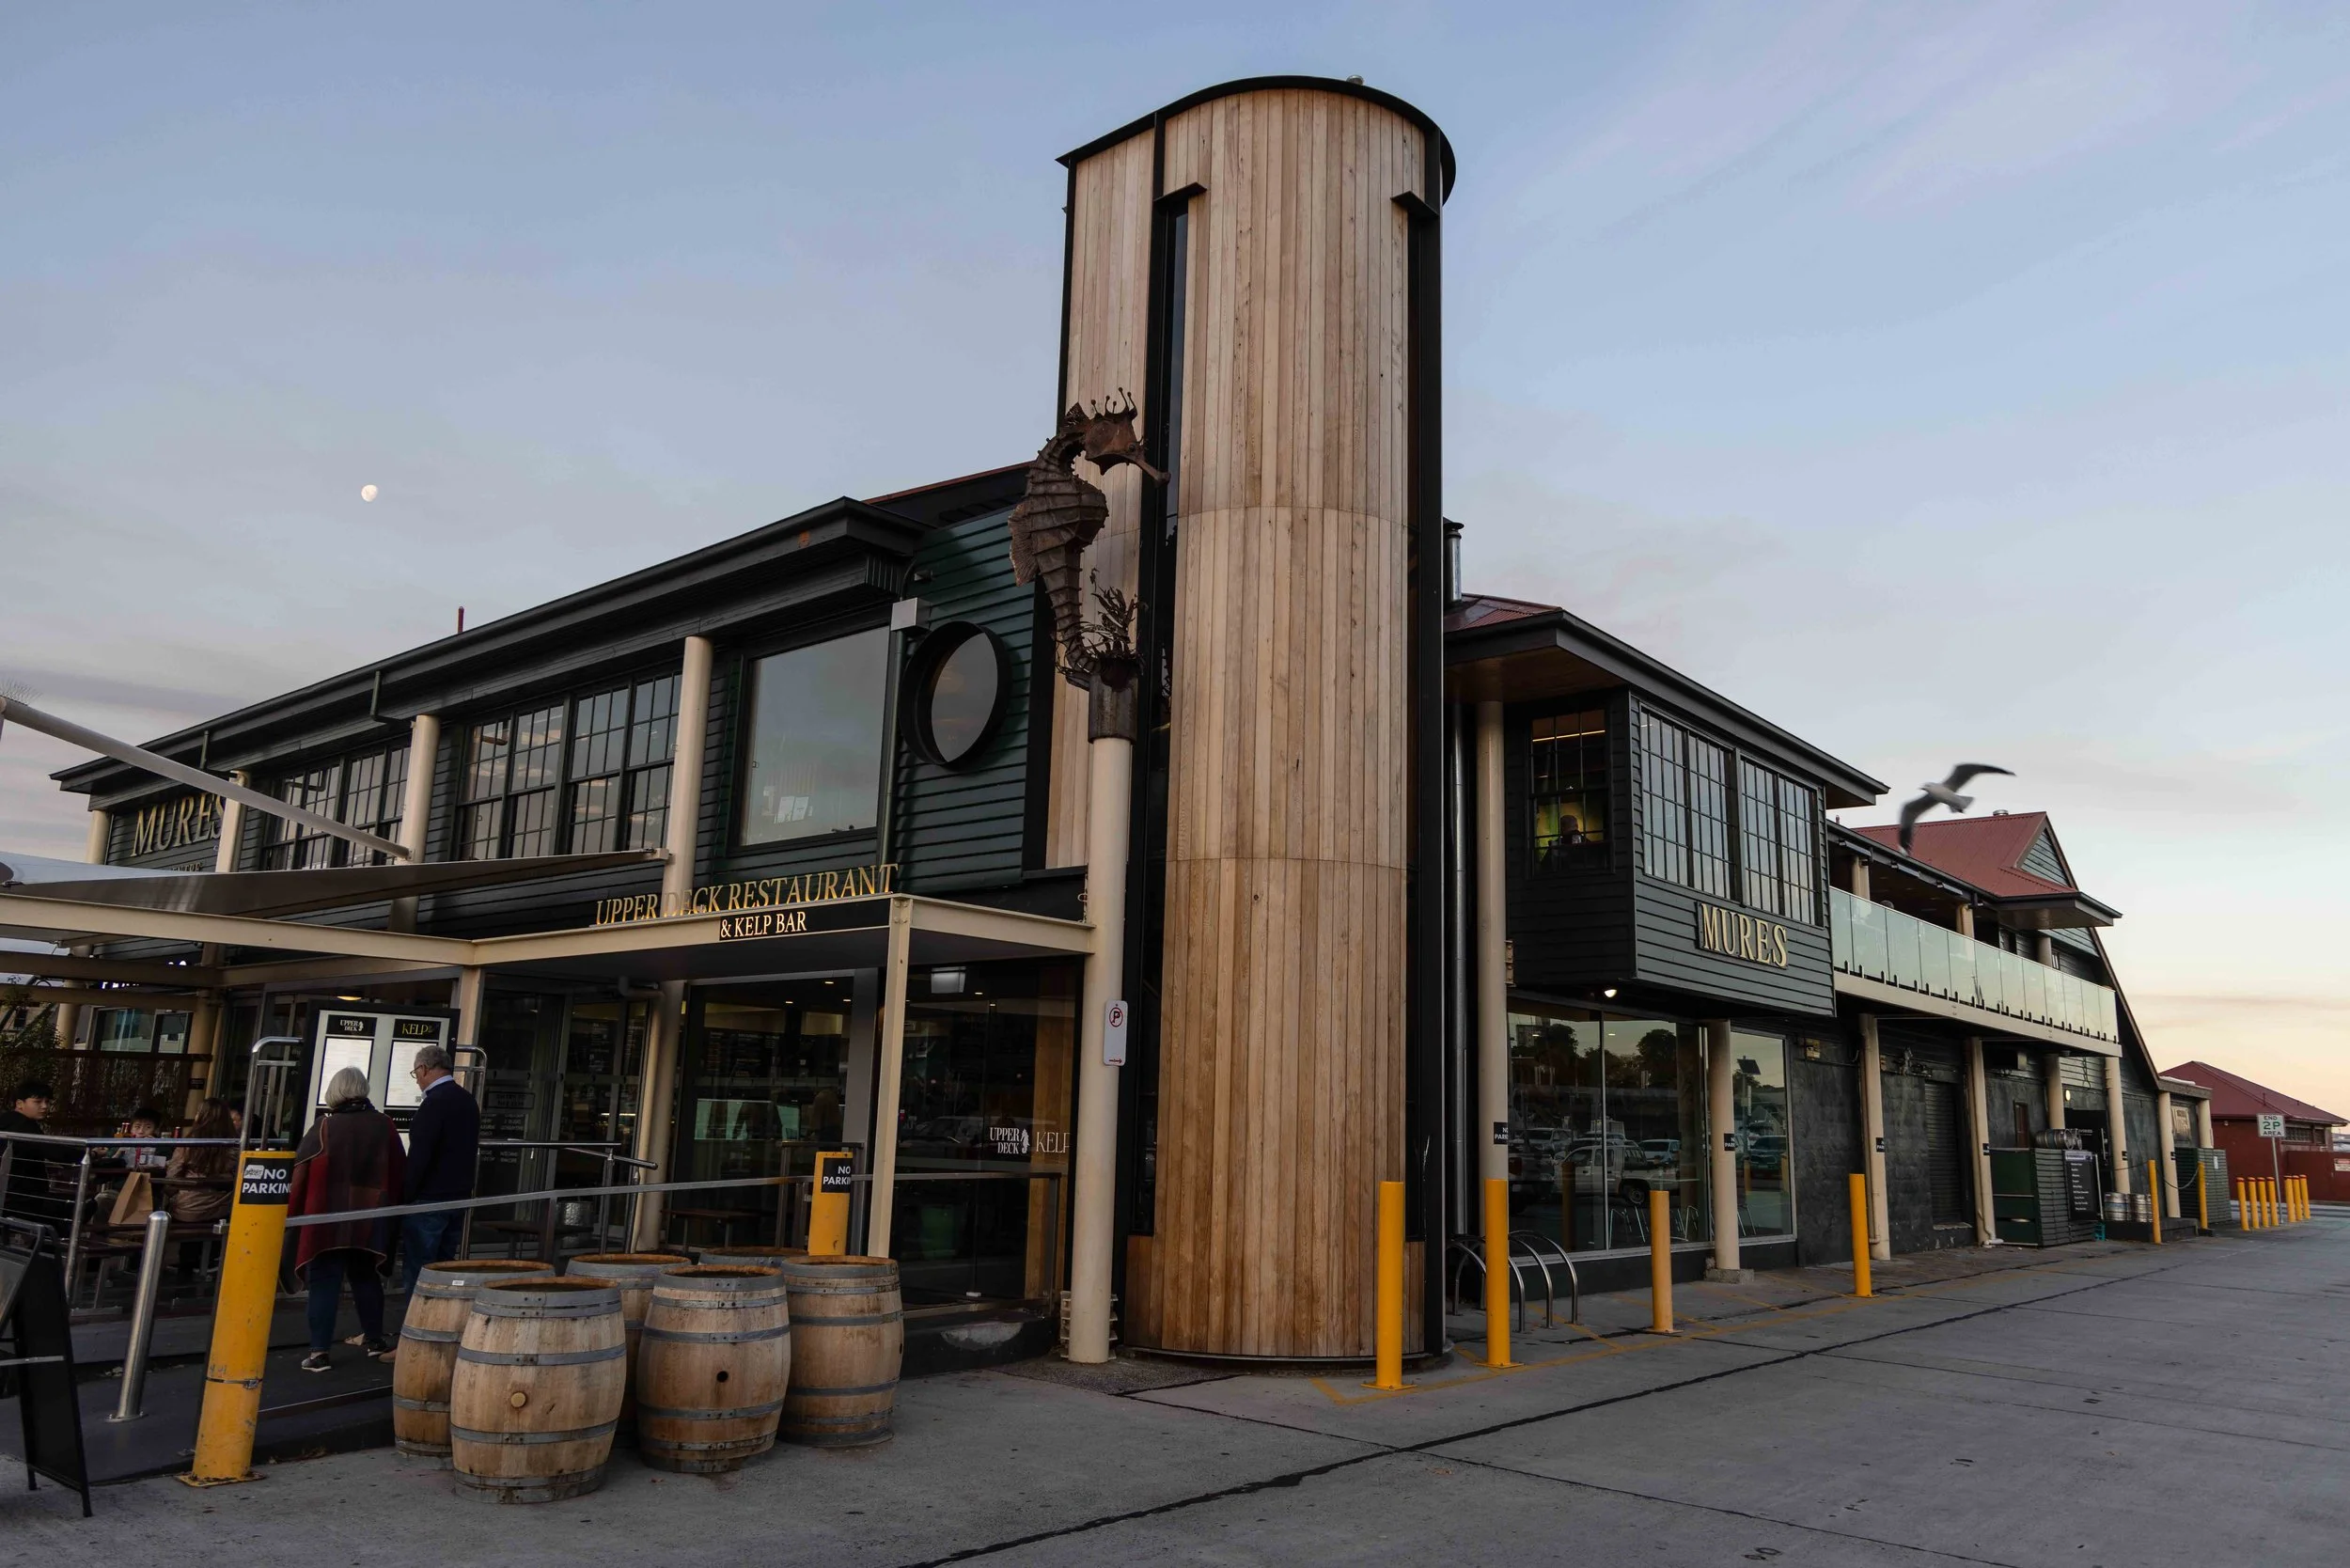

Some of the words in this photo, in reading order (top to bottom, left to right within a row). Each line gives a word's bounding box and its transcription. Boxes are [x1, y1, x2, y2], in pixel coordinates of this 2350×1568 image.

[130, 792, 225, 857] MURES
[595, 893, 658, 926] UPPER
[663, 885, 724, 919] DECK
[728, 863, 899, 911] RESTAURANT
[720, 918, 732, 938] &
[734, 915, 772, 938] KELP
[776, 911, 807, 934] BAR
[1700, 902, 1787, 968] MURES
[401, 1023, 429, 1036] KELP
[2263, 1121, 2280, 1130] 2P
[989, 1127, 1020, 1142] UPPER
[997, 1141, 1020, 1154] DECK
[263, 1168, 287, 1180] NO
[838, 1166, 852, 1174] NO
[242, 1183, 292, 1194] PARKIN
